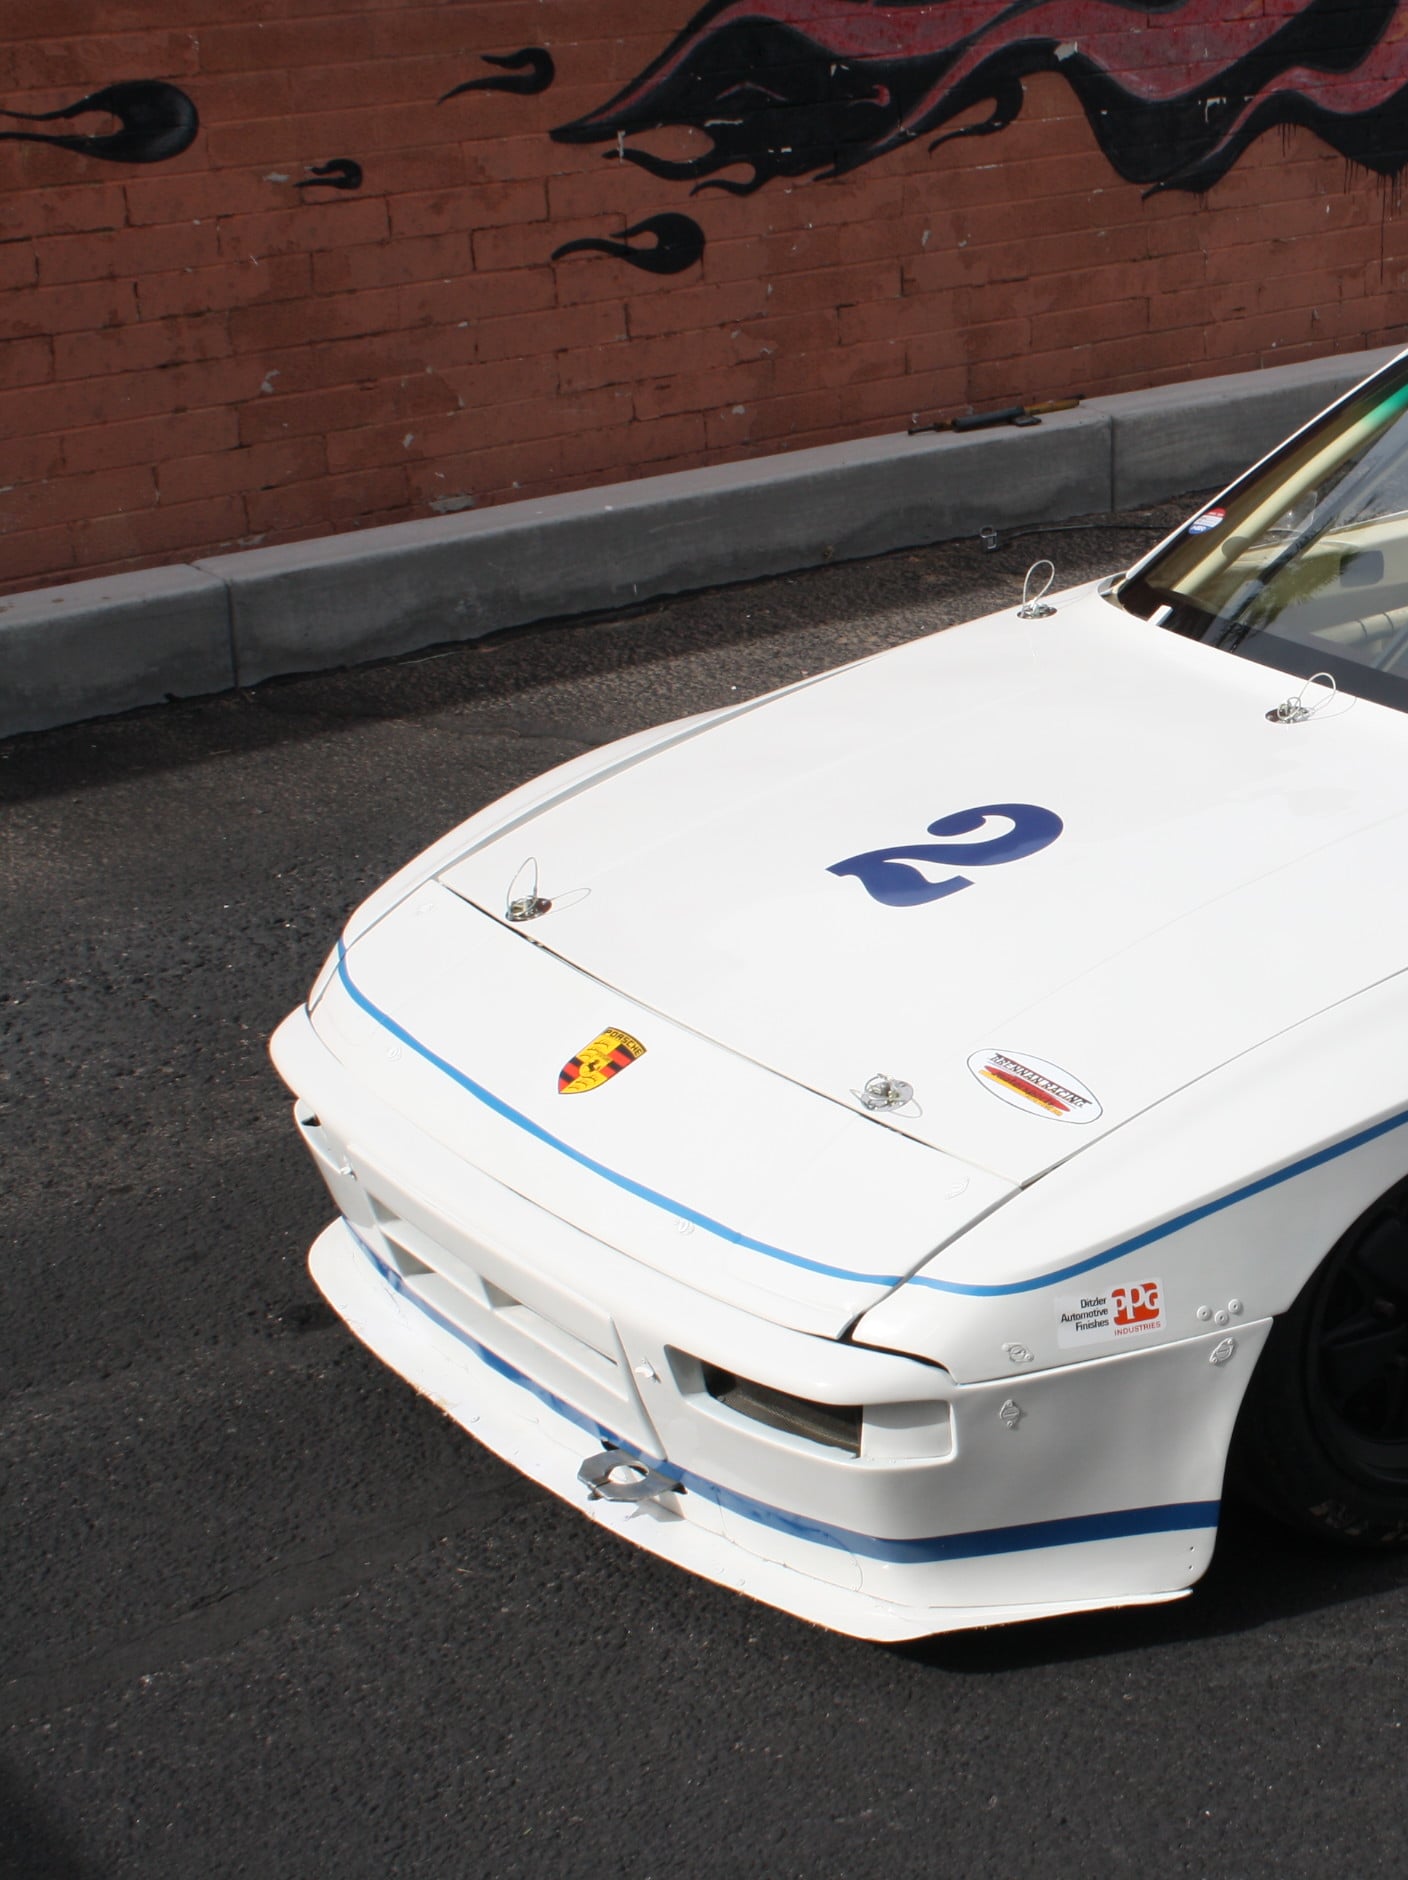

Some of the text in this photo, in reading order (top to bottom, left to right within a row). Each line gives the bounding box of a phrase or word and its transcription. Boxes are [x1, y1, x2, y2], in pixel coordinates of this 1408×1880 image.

[824, 802, 1064, 908] 2
[604, 1028, 643, 1057] PORSCHE
[1041, 1077, 1088, 1108] RACING
[1080, 1296, 1107, 1309] Ditzler
[1060, 1308, 1109, 1323] Automotive
[1075, 1318, 1110, 1332] Finishes
[1114, 1320, 1162, 1337] INDUSTRIES
